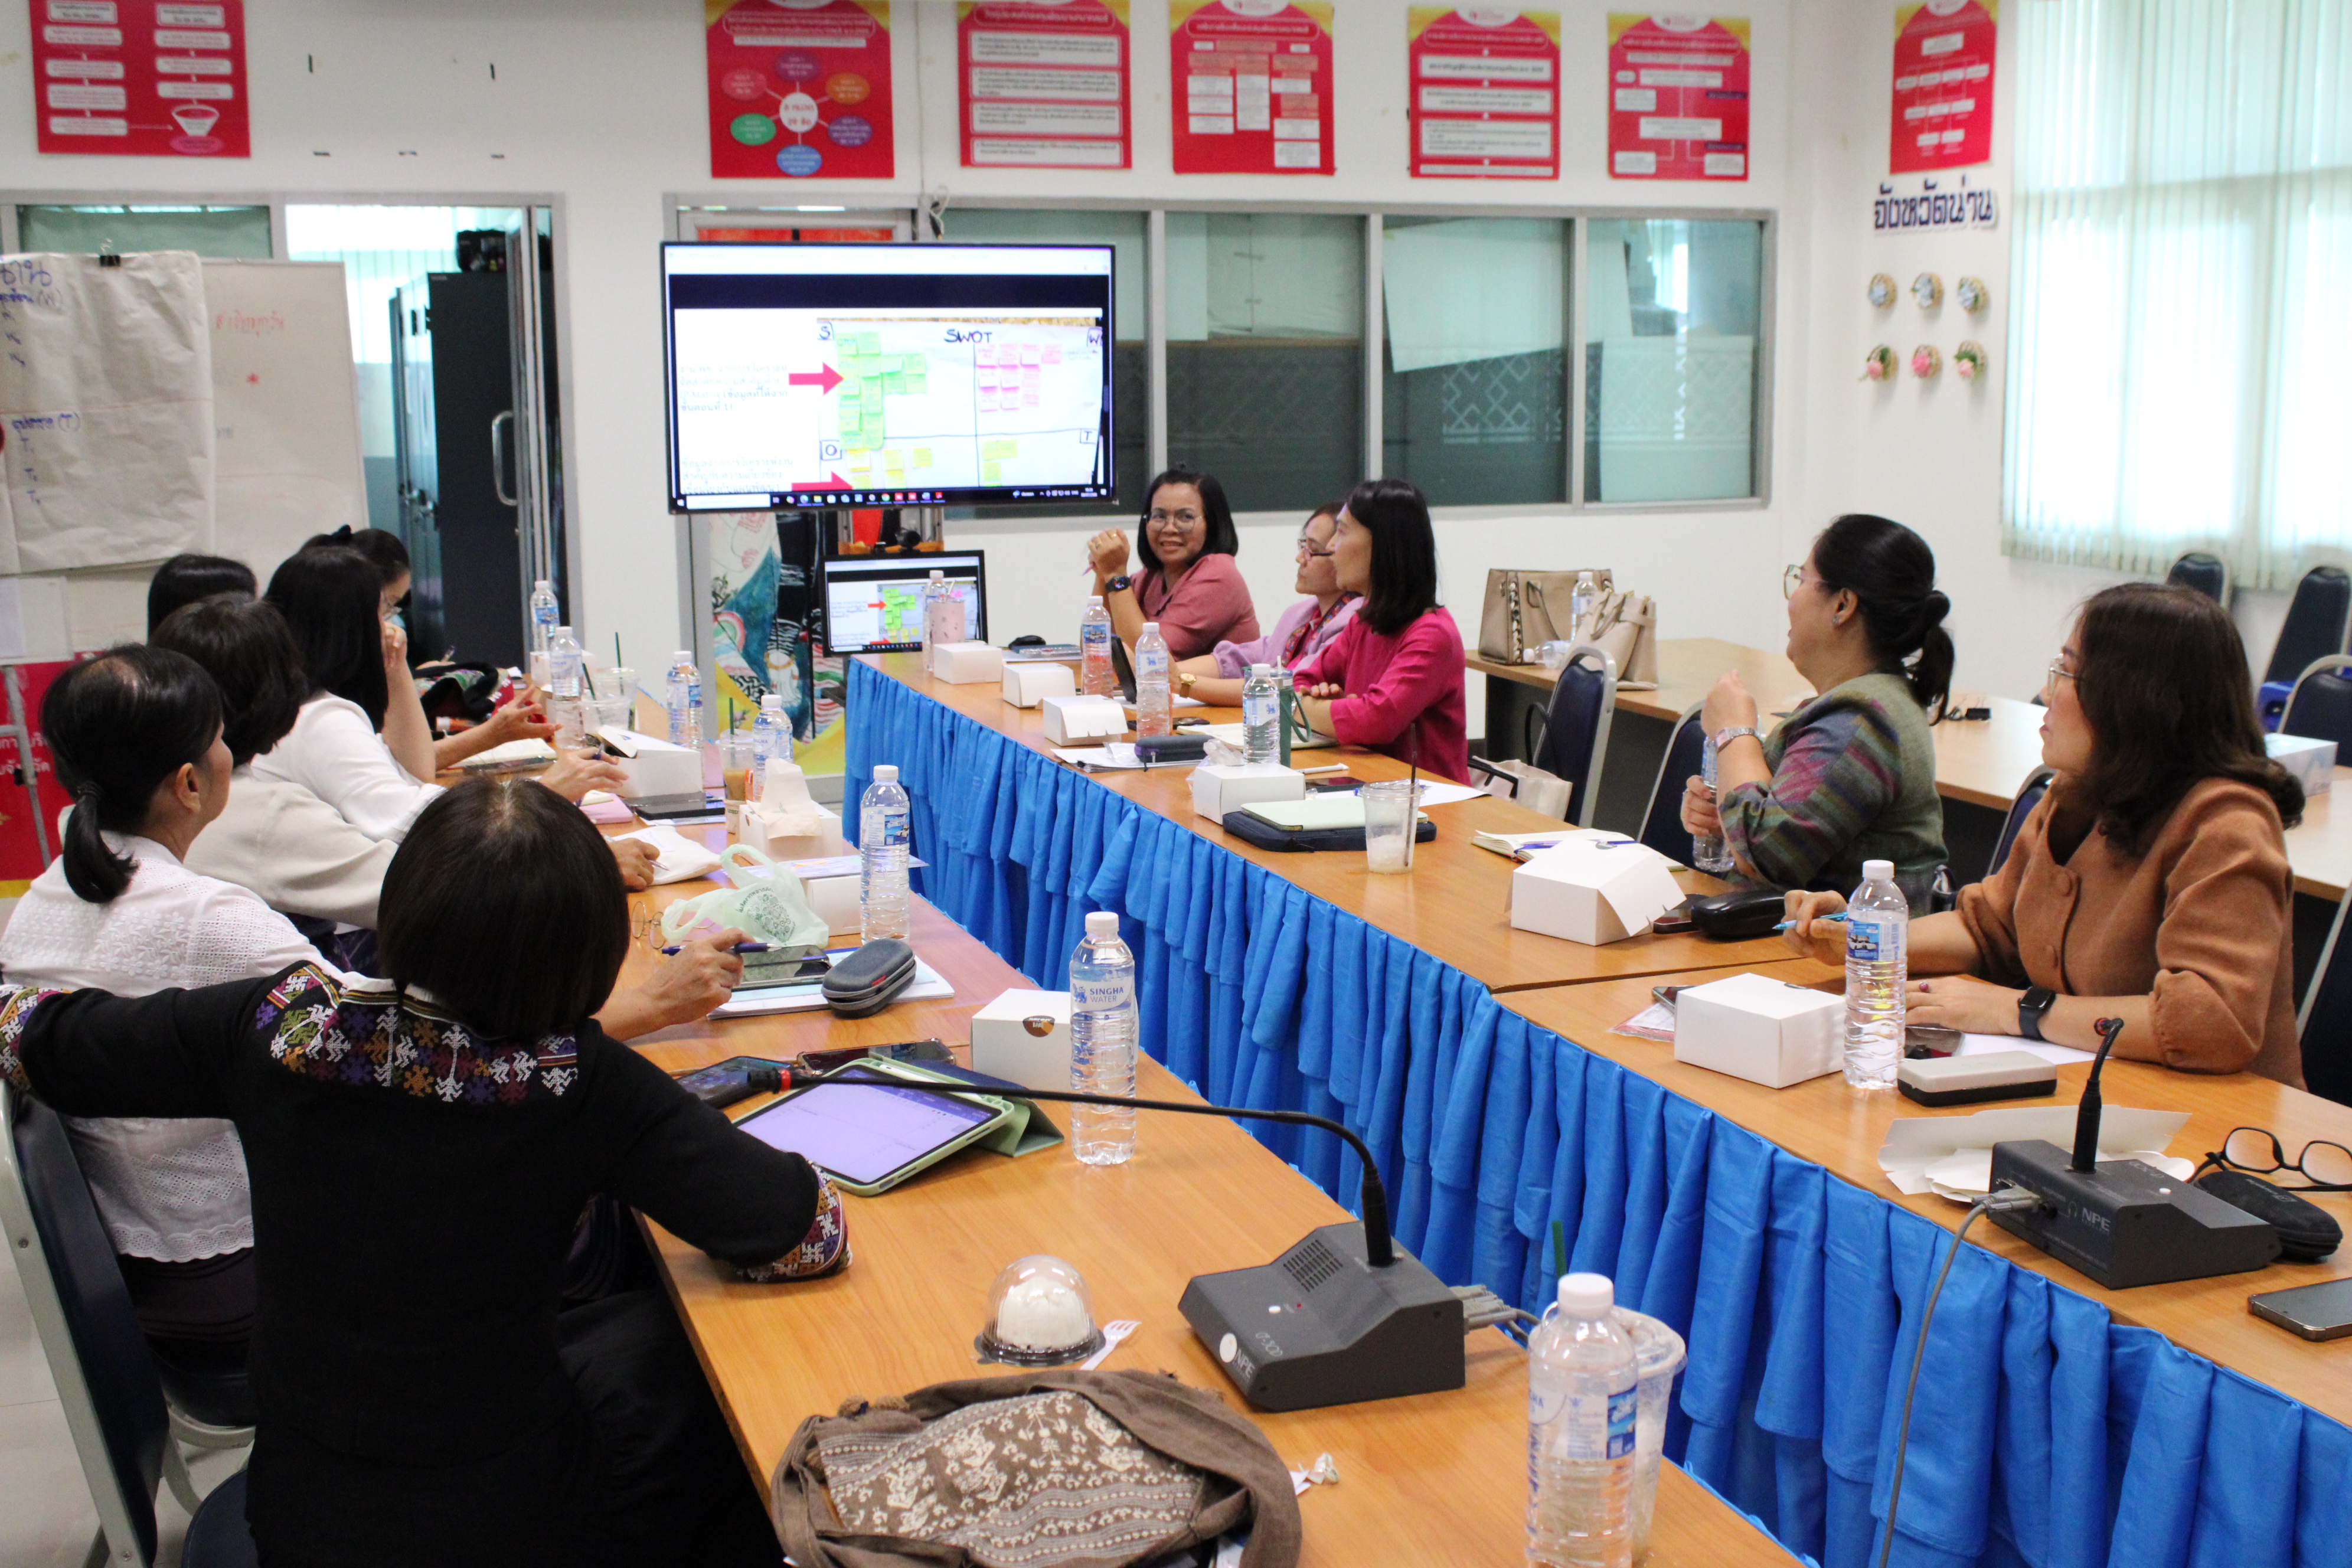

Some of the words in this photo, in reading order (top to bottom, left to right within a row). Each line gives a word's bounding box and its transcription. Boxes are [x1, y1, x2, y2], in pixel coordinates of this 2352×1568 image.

[1874, 174, 1994, 230] จังหวัดน่าน
[819, 326, 831, 340] S
[943, 329, 992, 343] SWOT
[1089, 334, 1101, 344] W
[1084, 431, 1092, 441] T
[825, 445, 837, 456] O
[1090, 986, 1124, 995] SINGHA
[2082, 1208, 2111, 1231] NPE
[1235, 1348, 1255, 1378] NPE
